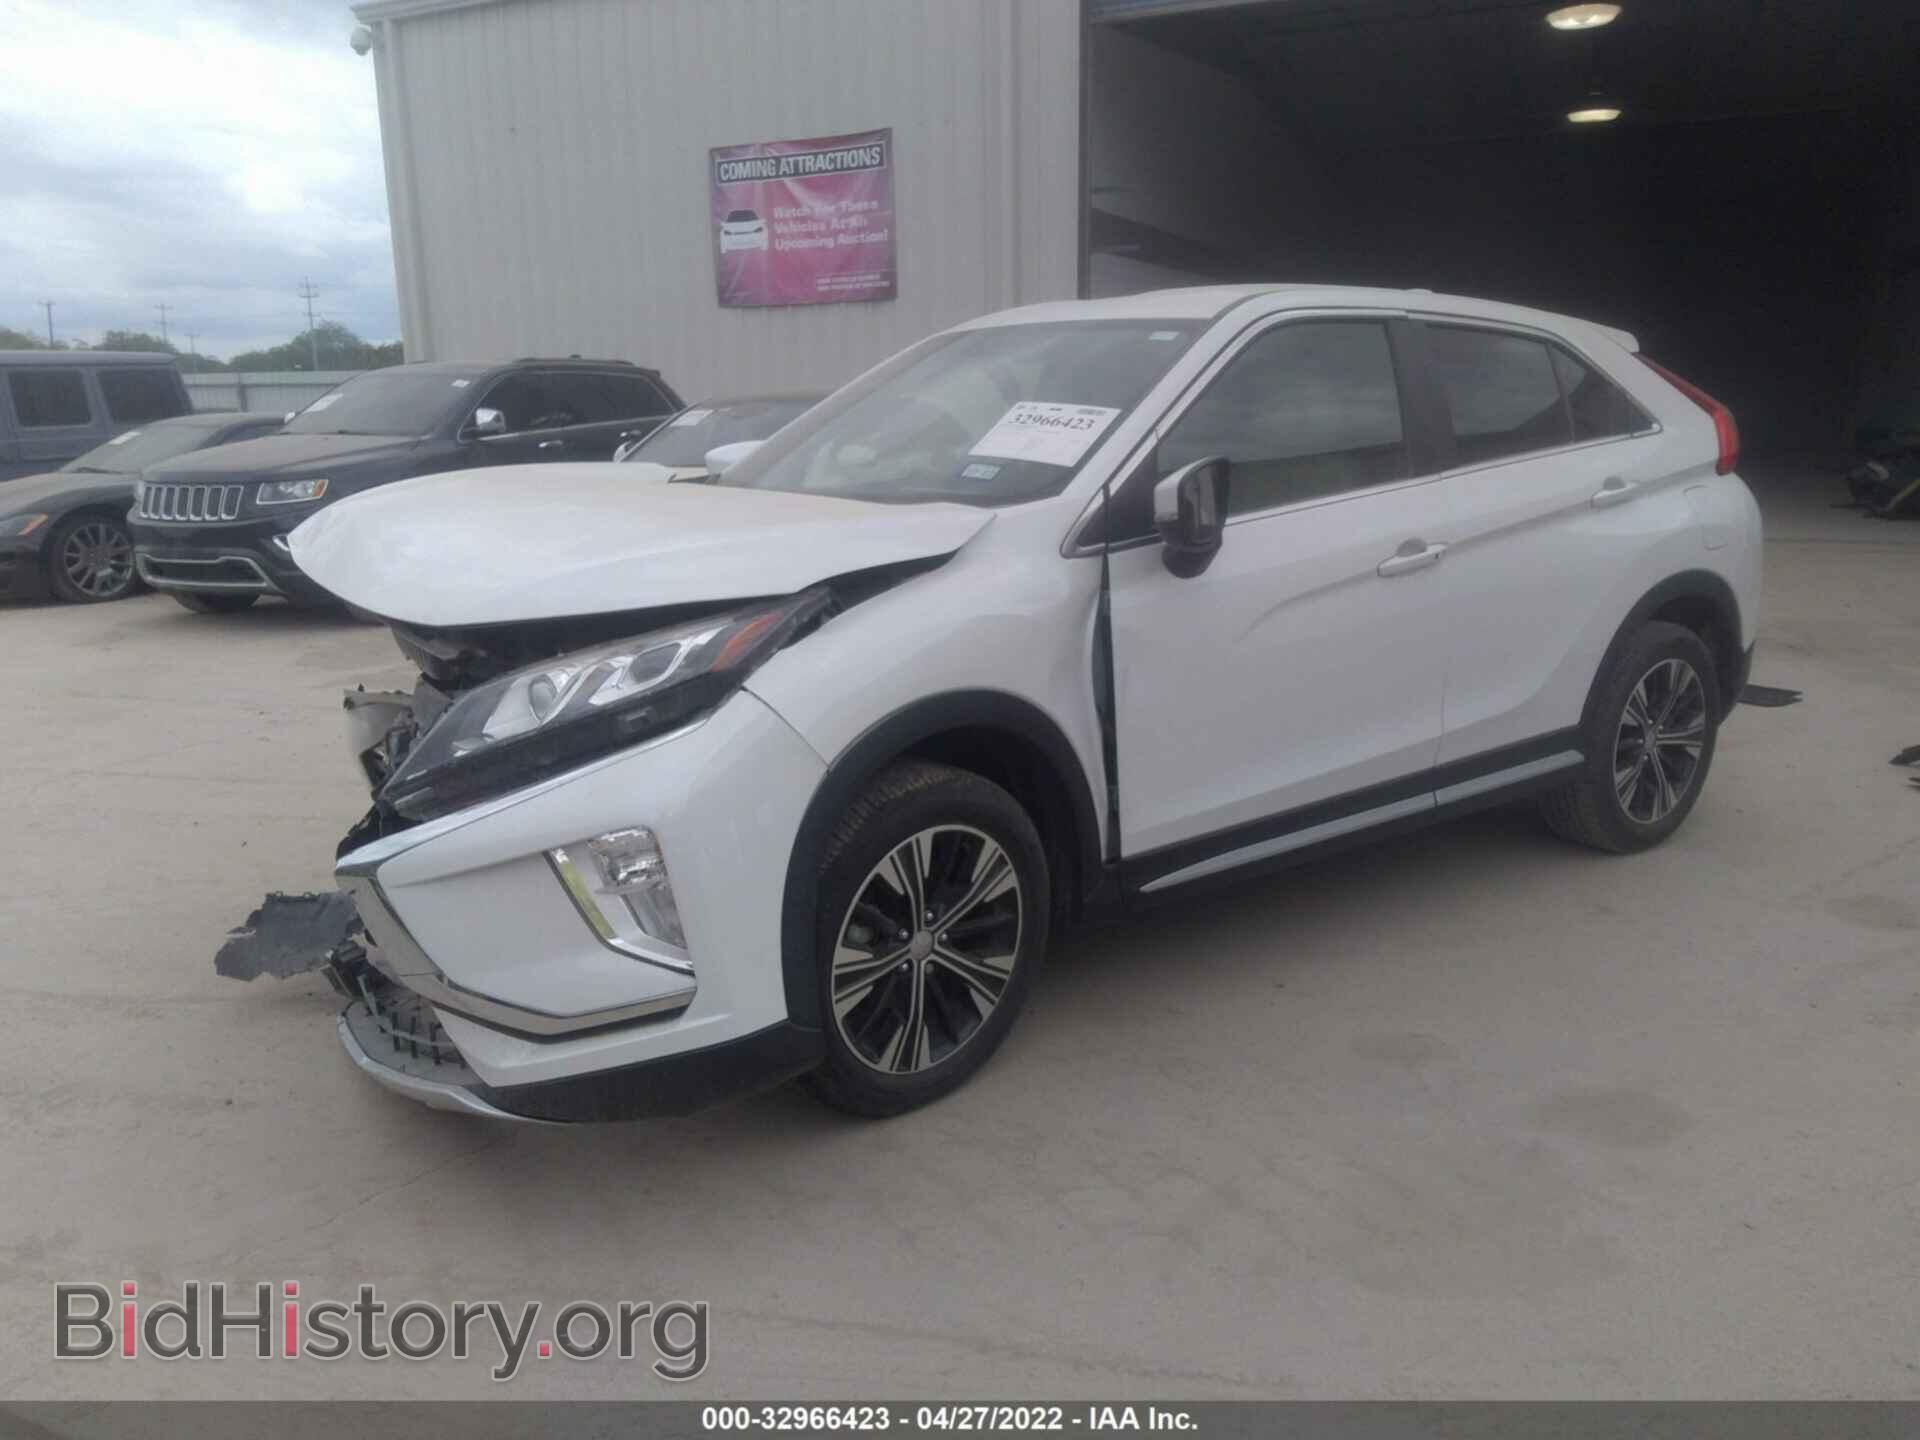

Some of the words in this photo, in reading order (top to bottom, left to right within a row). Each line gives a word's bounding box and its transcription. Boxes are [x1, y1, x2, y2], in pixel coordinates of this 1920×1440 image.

[720, 159, 776, 181] COMING
[779, 147, 881, 176] ATTRACTIONS
[1008, 413, 1096, 431] 32966423
